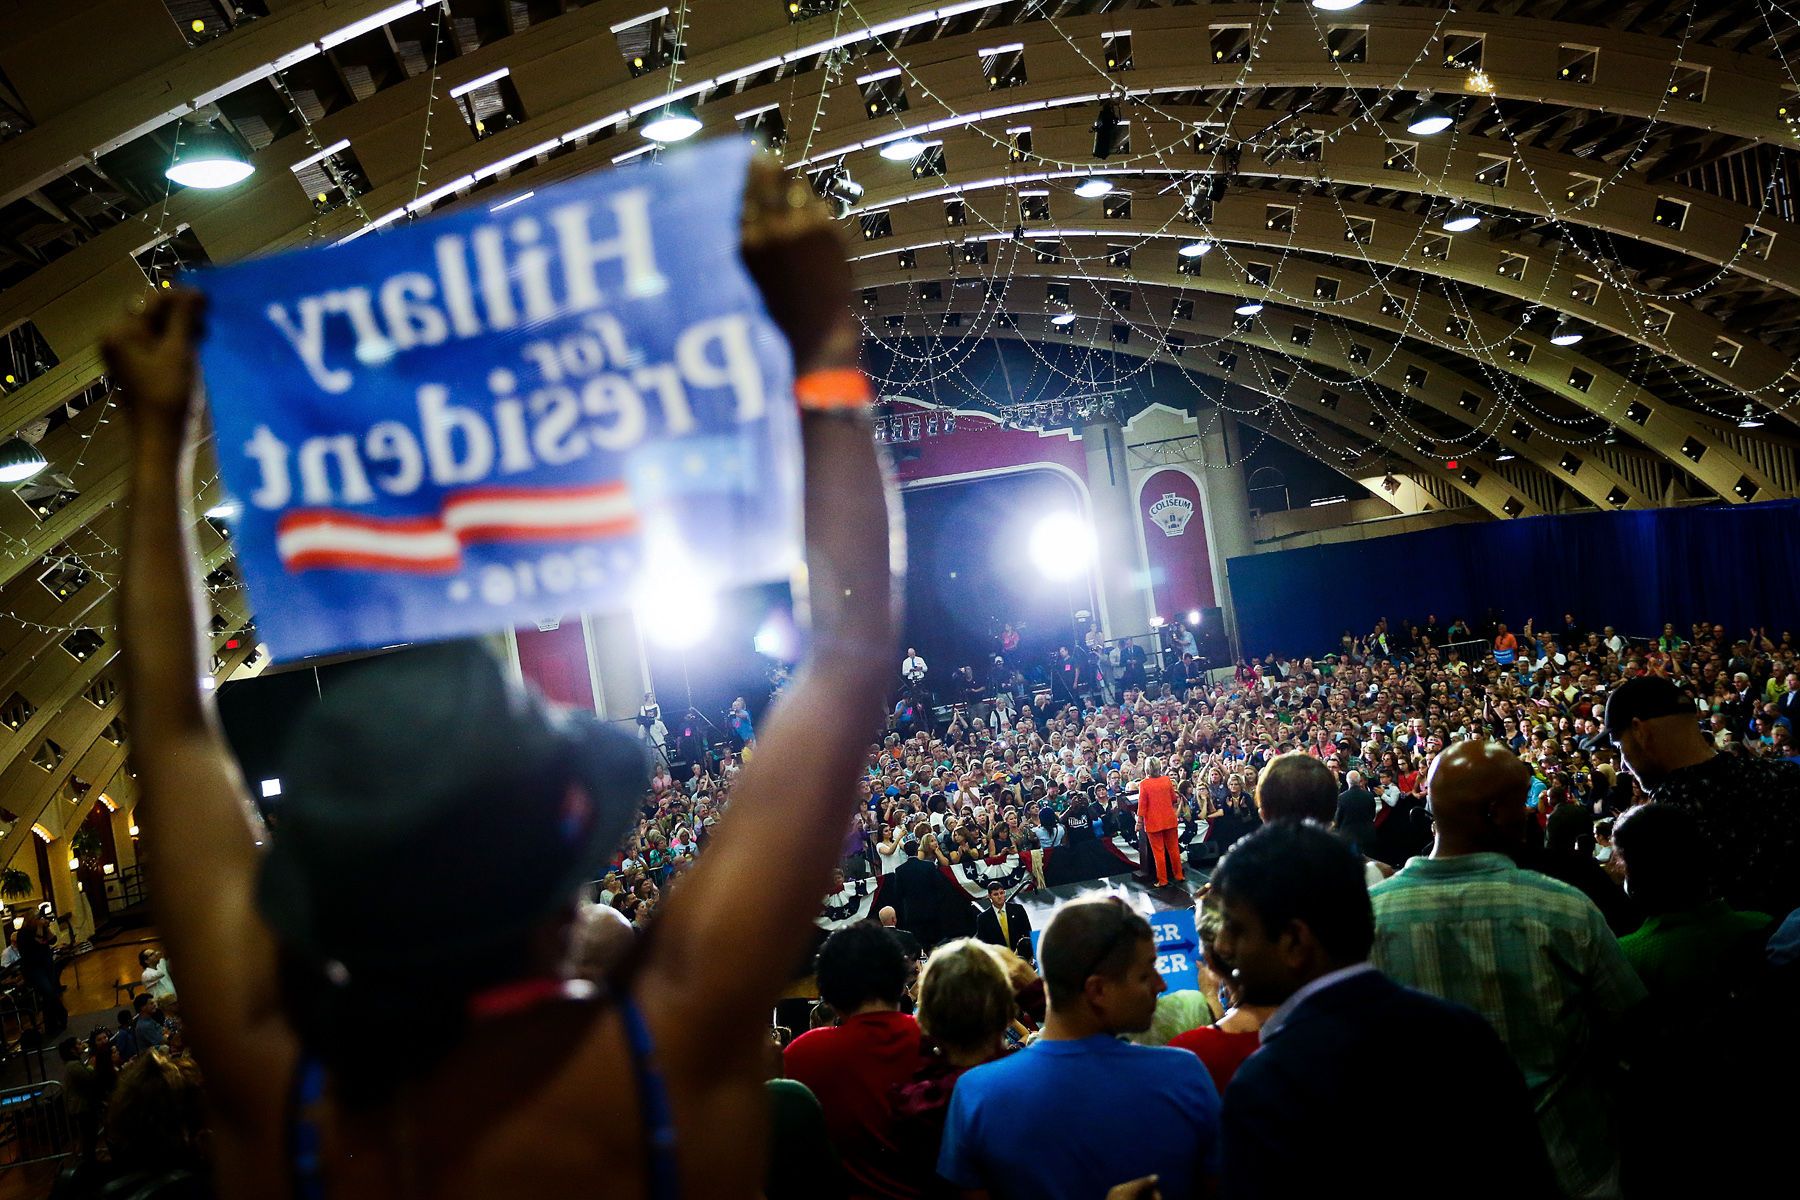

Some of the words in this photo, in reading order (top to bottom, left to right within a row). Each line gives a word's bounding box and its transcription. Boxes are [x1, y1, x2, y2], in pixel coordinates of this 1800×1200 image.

[1151, 498, 1191, 515] COLISEUM
[1151, 924, 1181, 943] ER
[1154, 954, 1188, 974] ER
